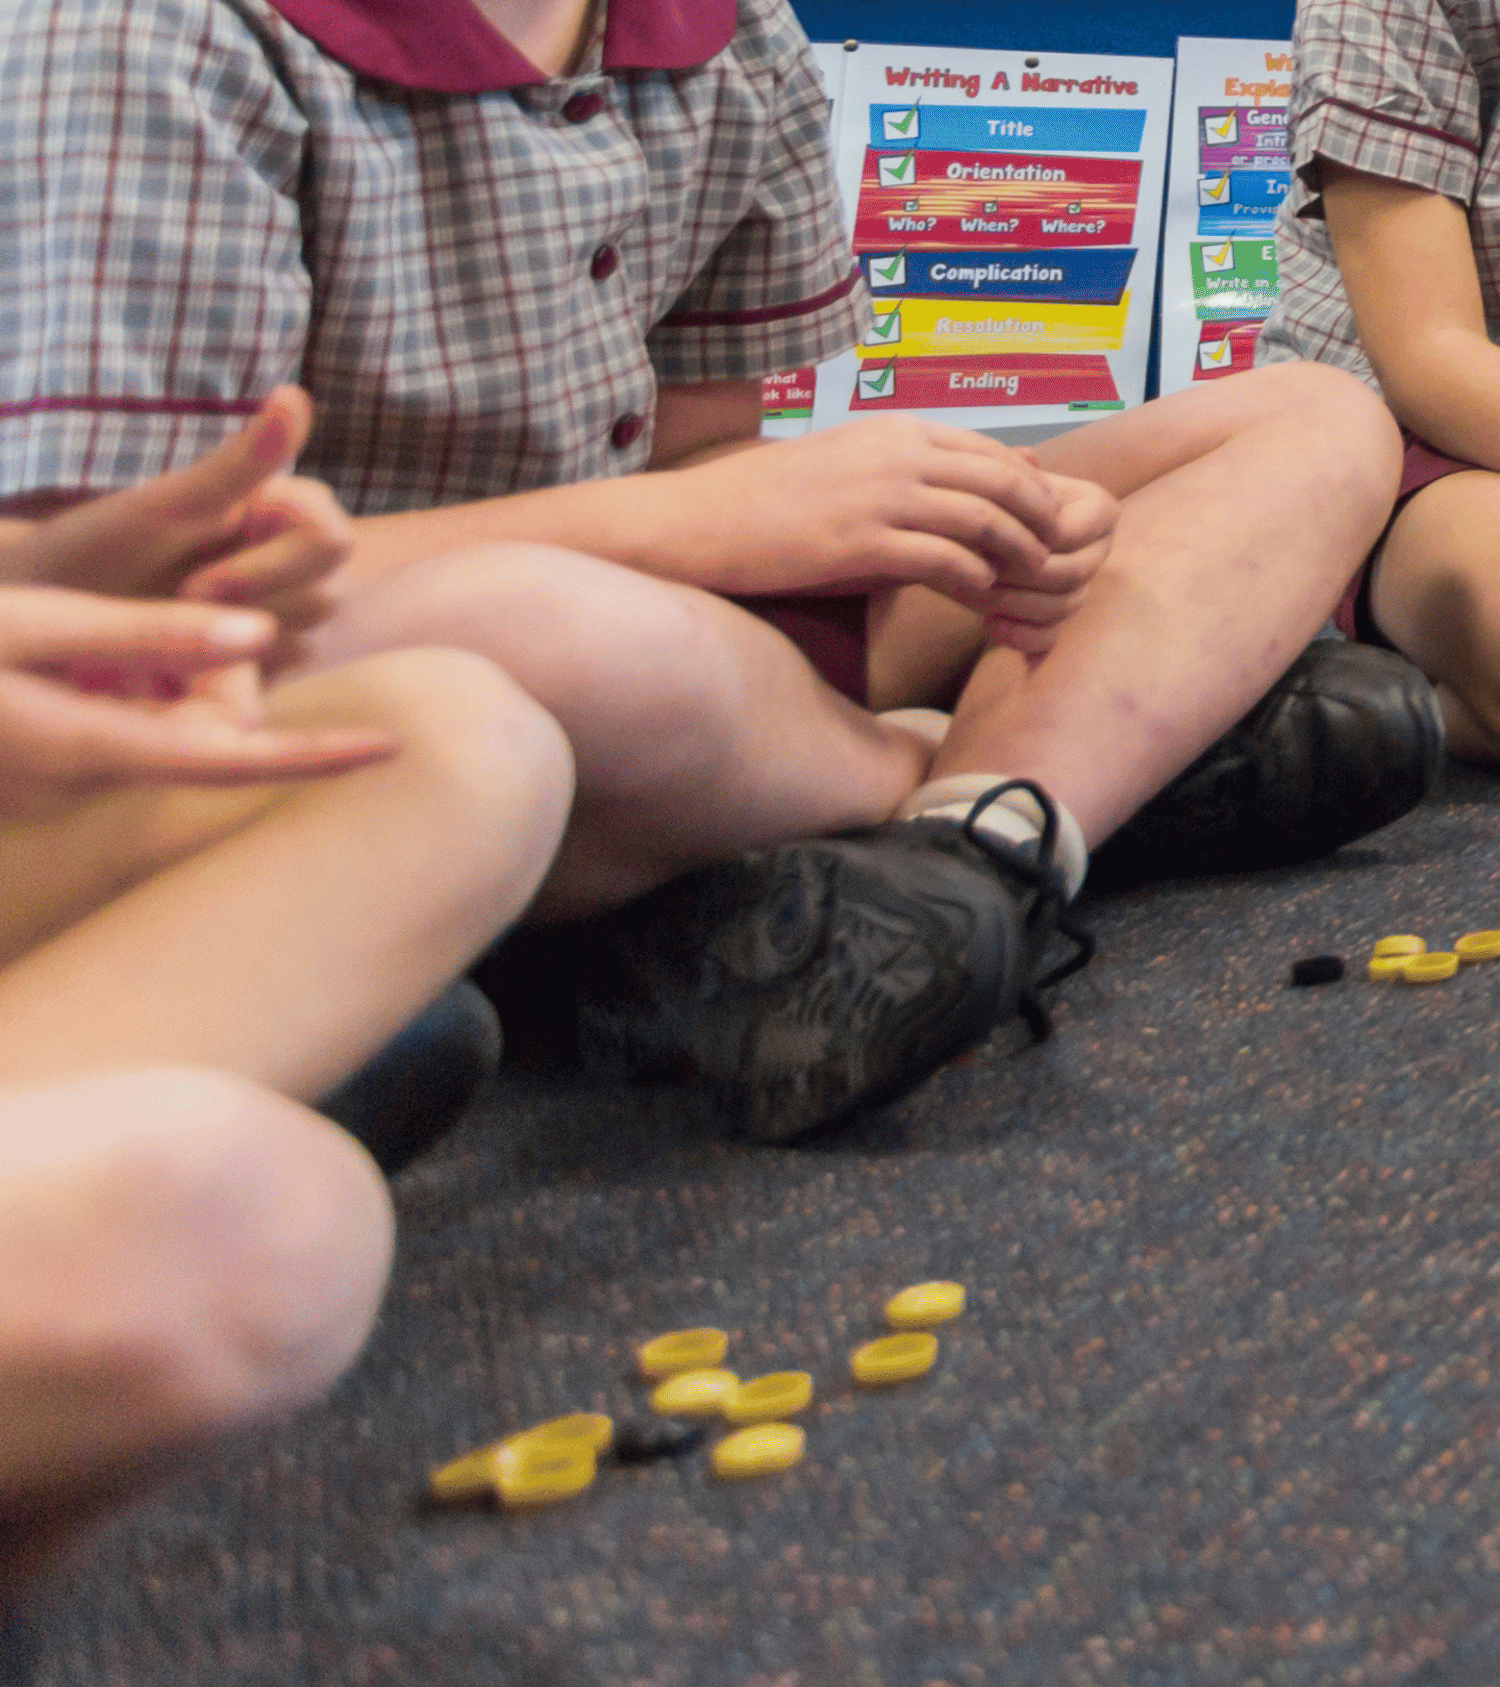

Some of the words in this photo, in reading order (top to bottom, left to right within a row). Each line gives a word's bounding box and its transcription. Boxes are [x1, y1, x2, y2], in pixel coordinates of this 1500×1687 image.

[885, 67, 980, 98] Writing
[992, 72, 1010, 91] A
[1021, 72, 1139, 96] Narrative
[988, 120, 1034, 138] Title
[946, 162, 1066, 182] Orientation
[888, 216, 937, 233] Who?
[960, 217, 1020, 234] When?
[1041, 218, 1106, 235] Where?
[929, 262, 1063, 289] Complication
[935, 316, 1045, 335] Resolution
[949, 371, 1019, 395] Ending
[787, 386, 812, 401] like
